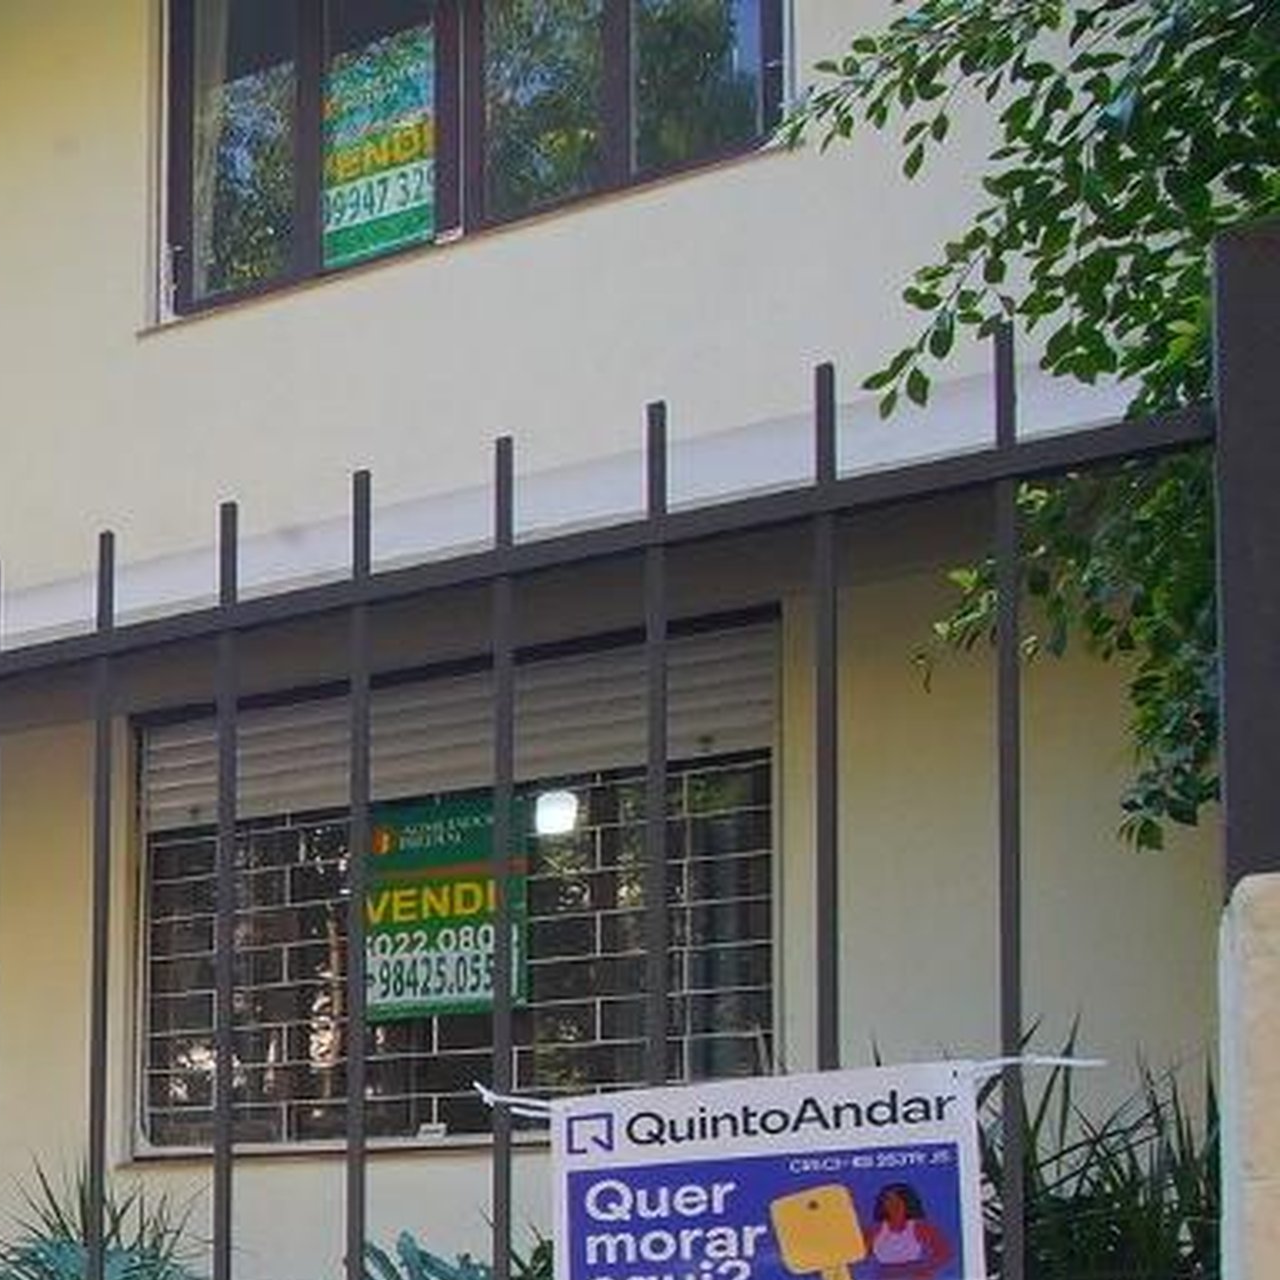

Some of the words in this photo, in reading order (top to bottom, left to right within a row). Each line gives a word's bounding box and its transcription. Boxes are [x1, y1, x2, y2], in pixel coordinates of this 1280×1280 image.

[365, 880, 497, 924] VEND
[626, 1090, 957, 1147] QuintoAndar
[584, 1179, 737, 1224] Quer
[585, 1223, 767, 1265] morar
